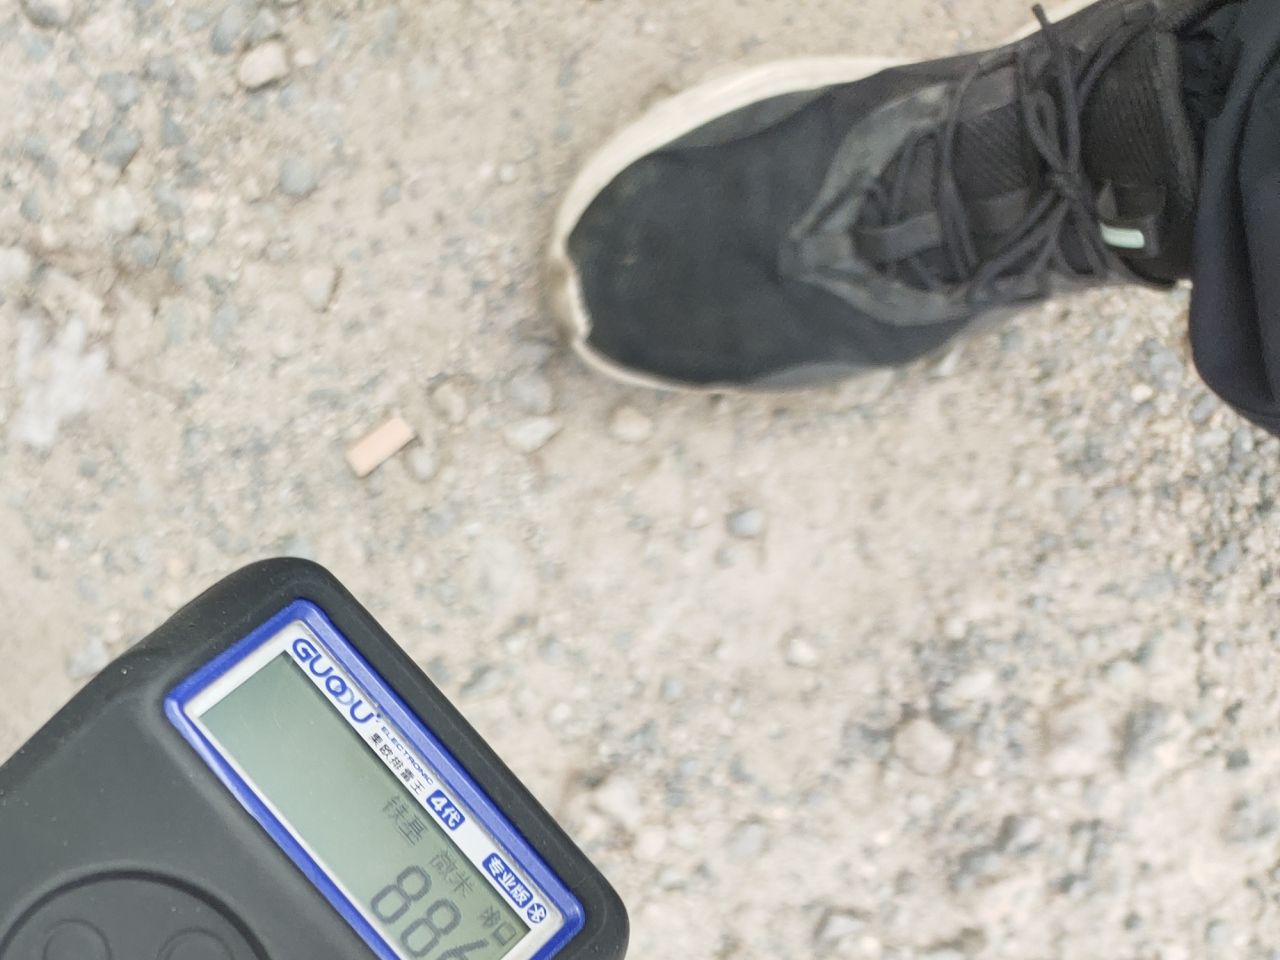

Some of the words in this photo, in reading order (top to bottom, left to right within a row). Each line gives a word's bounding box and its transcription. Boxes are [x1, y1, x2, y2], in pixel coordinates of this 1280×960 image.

[380, 726, 434, 786] ELECTRONIC
[430, 795, 461, 828] 4代
[488, 855, 531, 907] 专业版
